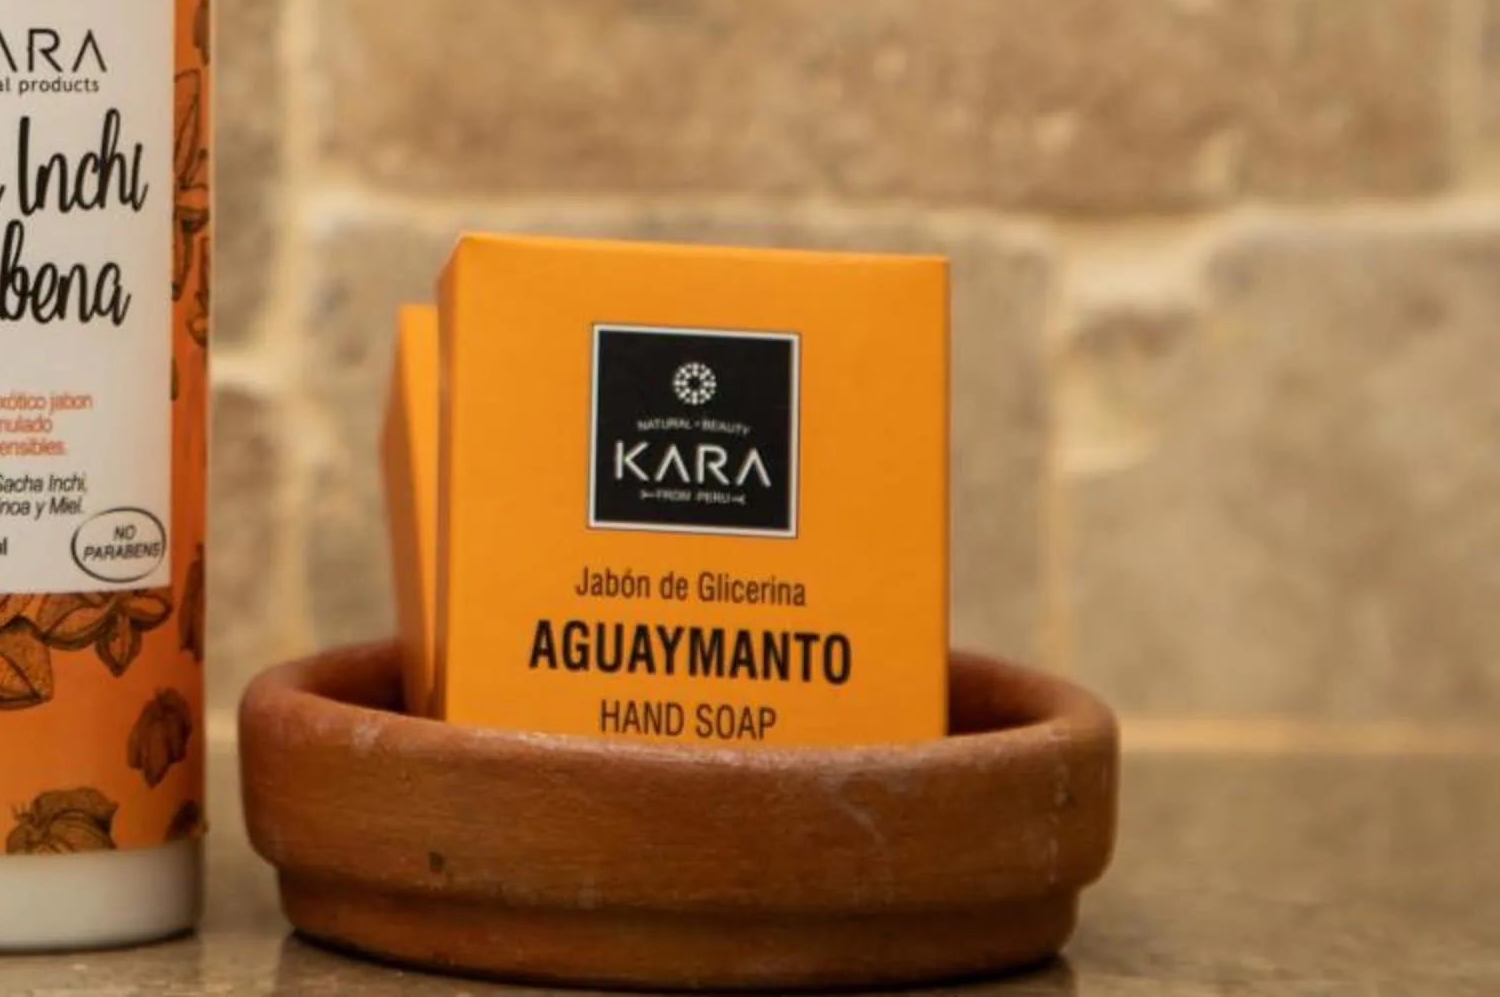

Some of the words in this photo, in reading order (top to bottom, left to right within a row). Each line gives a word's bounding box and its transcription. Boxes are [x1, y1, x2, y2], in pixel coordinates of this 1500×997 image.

[18, 76, 101, 95] products
[17, 107, 150, 217] Inchi
[614, 439, 772, 489] KARA
[33, 502, 46, 521] y
[113, 525, 138, 541] NO
[575, 567, 651, 599] Jabón
[659, 571, 689, 600] de
[697, 571, 806, 607] Glicerina
[528, 618, 852, 686] AGUAYMANTO
[600, 699, 685, 737] HAND
[695, 703, 777, 740] SOAP
